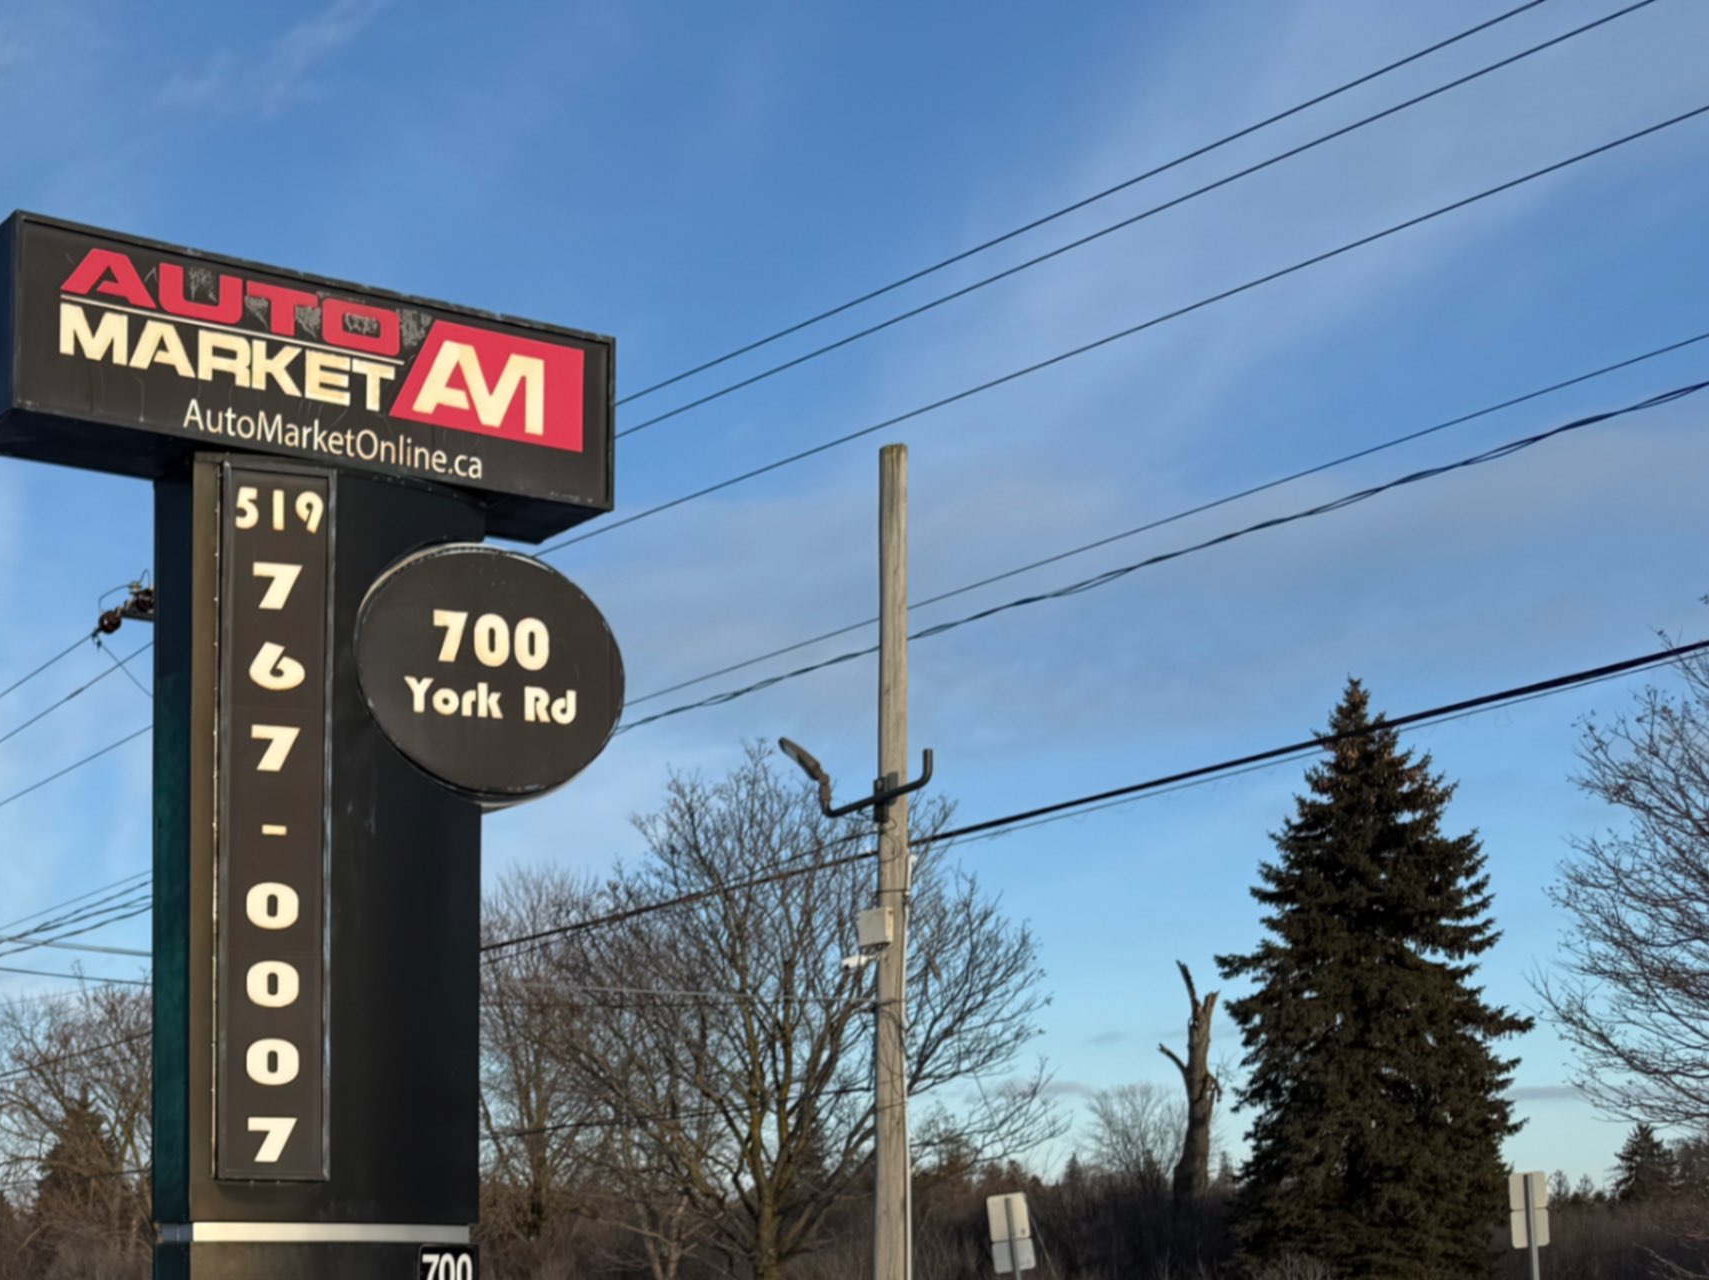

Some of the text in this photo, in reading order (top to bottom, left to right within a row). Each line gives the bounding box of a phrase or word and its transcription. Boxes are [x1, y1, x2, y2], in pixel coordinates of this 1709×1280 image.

[60, 248, 401, 357] AUTO
[59, 302, 396, 412] MARKET
[411, 340, 545, 436] AM
[183, 398, 483, 479] AutoMarketOnline.ca
[235, 486, 324, 534] 519
[432, 608, 551, 671] 700
[404, 675, 578, 725] York Rd
